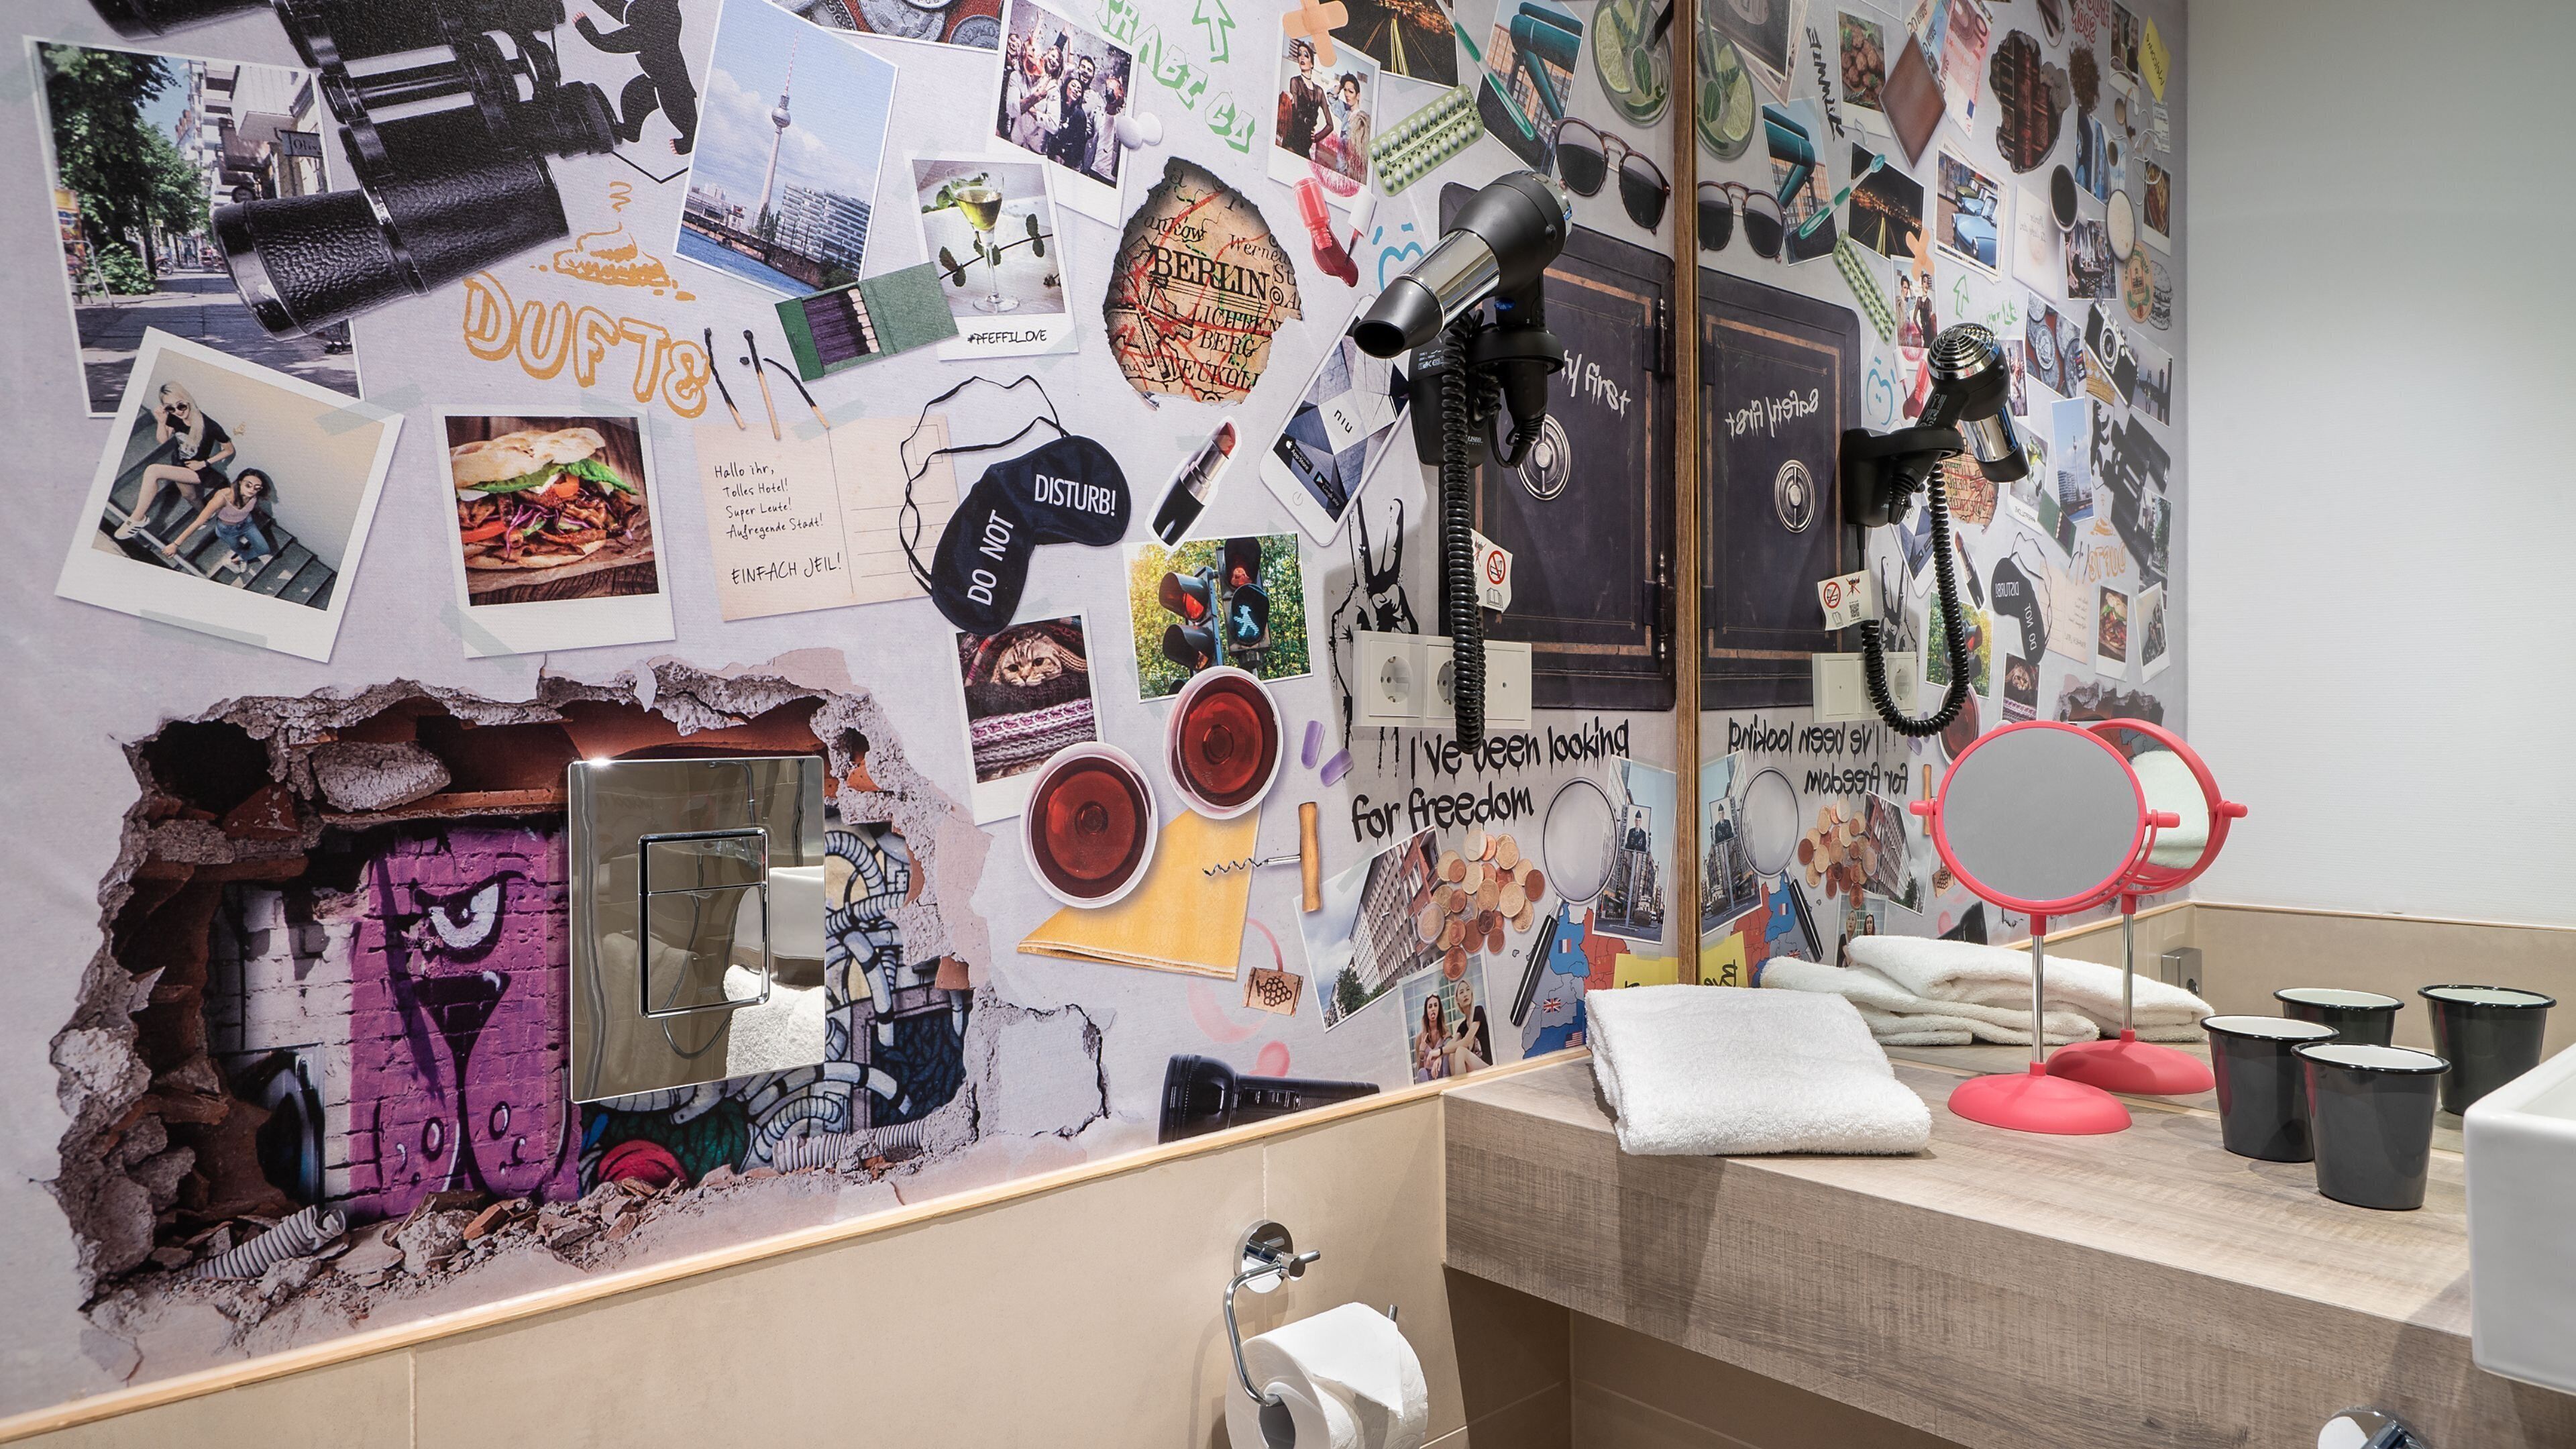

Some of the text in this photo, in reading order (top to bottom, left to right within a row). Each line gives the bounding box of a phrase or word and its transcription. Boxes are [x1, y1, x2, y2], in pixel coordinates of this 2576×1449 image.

[1148, 244, 1270, 301] BERLIN
[714, 462, 774, 478] Hallo ihr,
[722, 477, 788, 498] Tolles Hotel!
[726, 496, 792, 522] Super Leute!
[1034, 474, 1116, 517] DISTURB!
[726, 512, 824, 540] Aufregende Stadt!
[731, 552, 842, 585] EINFACH JEIL!
[967, 509, 1014, 606] DO NOT
[1548, 716, 1629, 769] looking
[1352, 780, 1535, 844] for freedom
